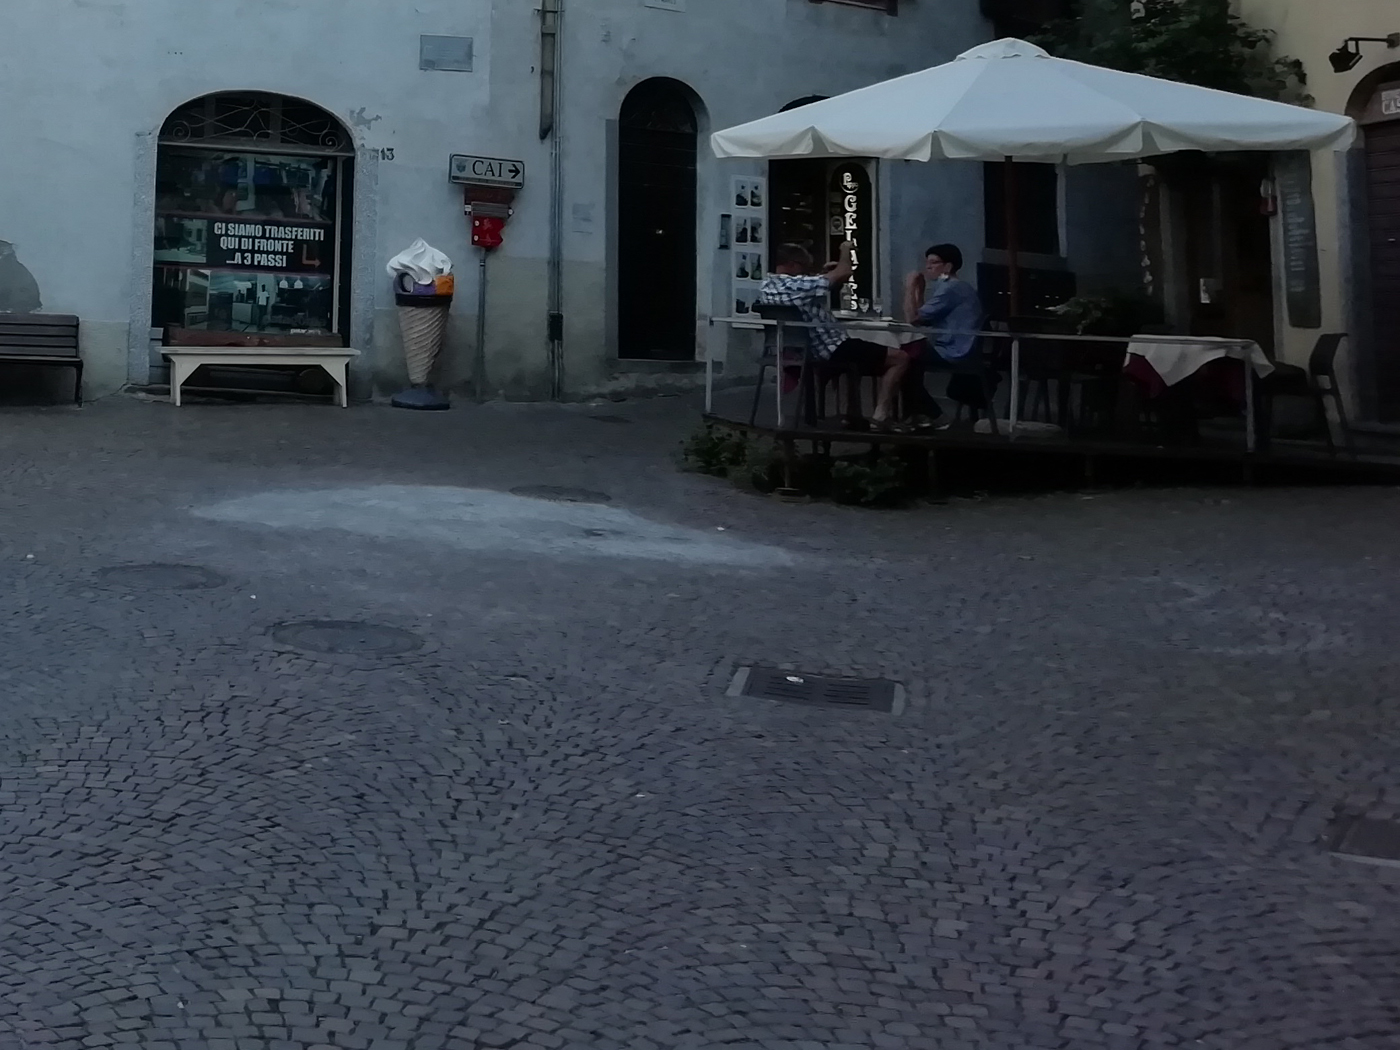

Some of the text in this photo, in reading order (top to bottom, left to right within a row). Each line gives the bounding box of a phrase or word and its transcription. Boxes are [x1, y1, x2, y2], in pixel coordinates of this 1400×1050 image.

[380, 147, 395, 161] 13
[472, 159, 504, 178] CAI
[214, 222, 325, 241] CI SIAMO TRASFERITI
[220, 236, 295, 253] QUI DI FRONTE
[244, 252, 252, 266] 3
[254, 253, 287, 267] PASSI
